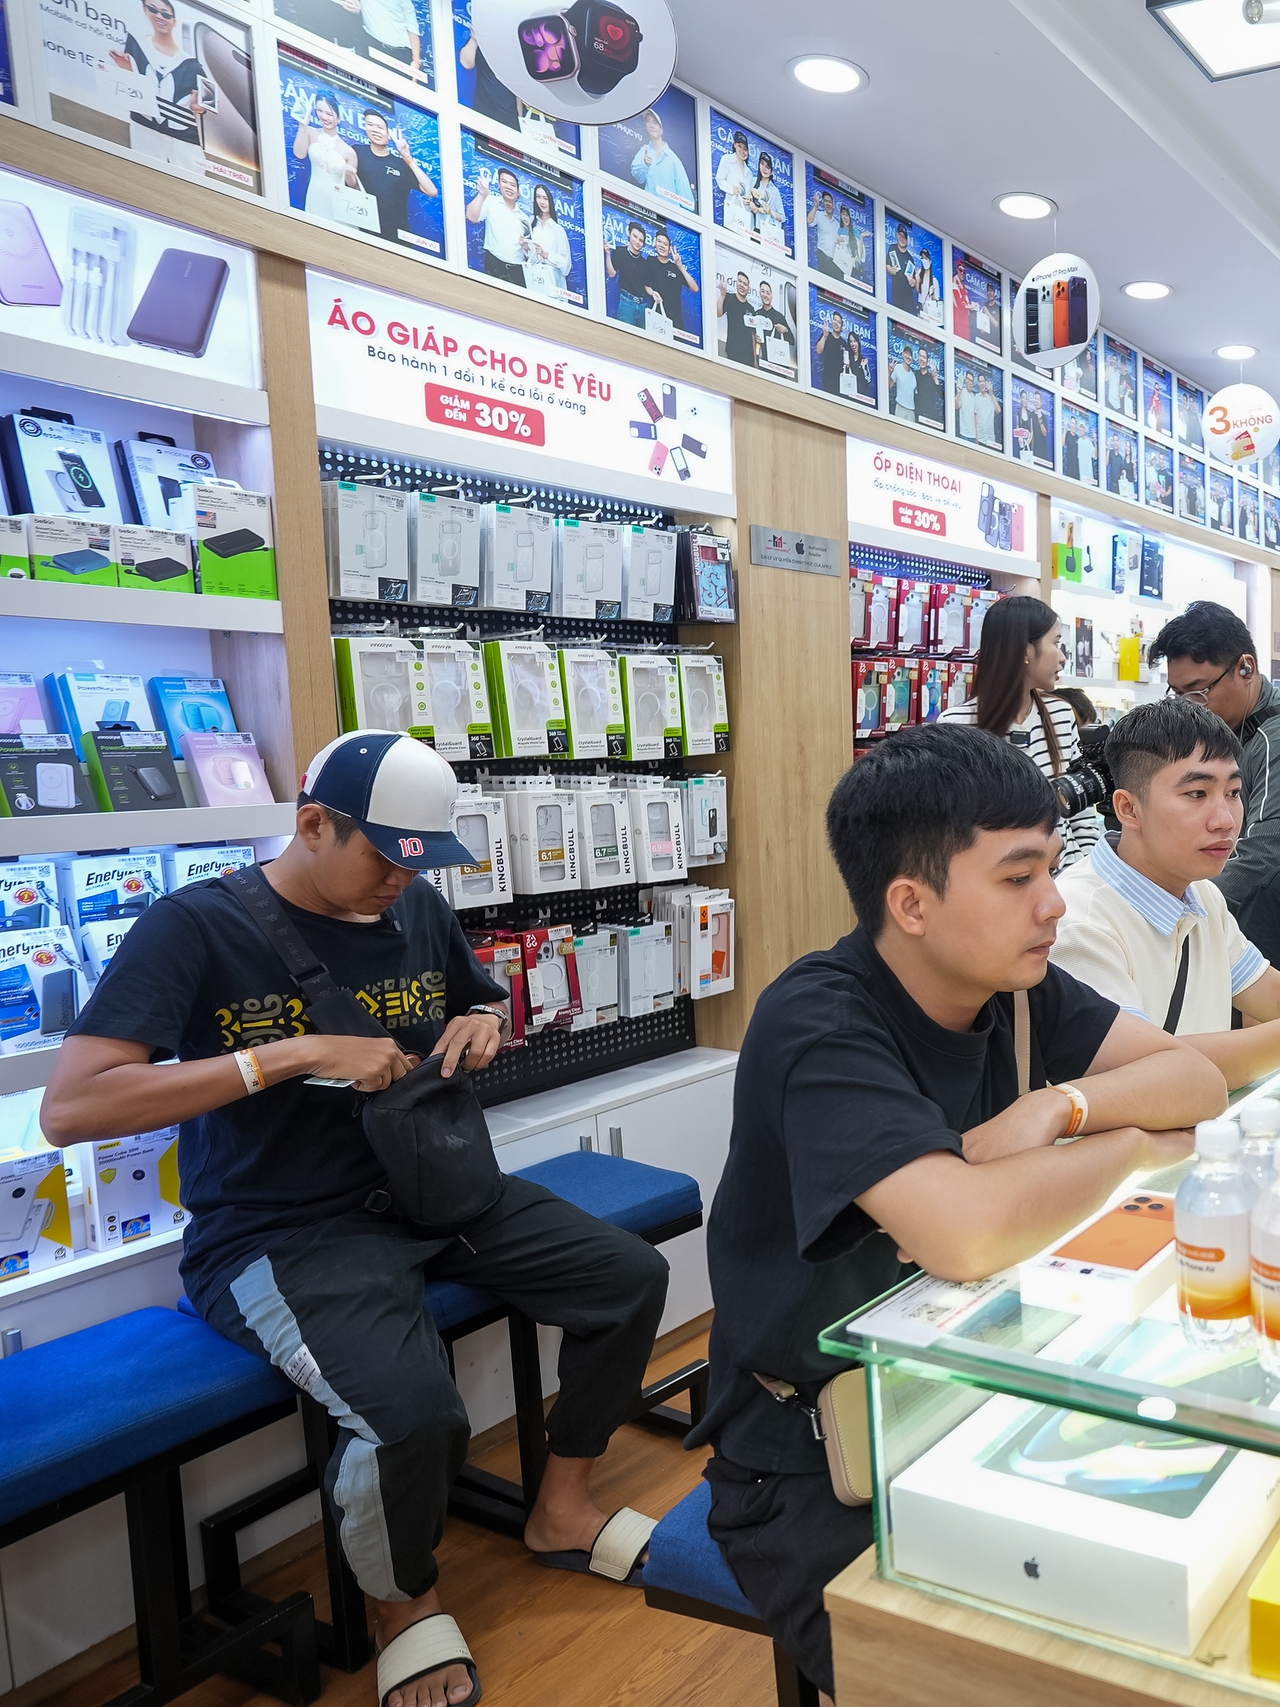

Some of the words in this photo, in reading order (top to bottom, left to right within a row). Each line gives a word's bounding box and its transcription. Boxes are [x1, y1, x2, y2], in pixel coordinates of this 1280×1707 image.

[593, 41, 605, 51] 68
[1036, 271, 1052, 282] iPhone
[327, 298, 376, 336] ÁO
[387, 321, 459, 356] GIÁP
[468, 345, 528, 378] CHO
[536, 362, 569, 390] DẾ
[573, 372, 612, 403] YÊU
[367, 345, 397, 364] Bảo
[401, 354, 437, 374] hành
[454, 368, 475, 385] đổi
[490, 377, 506, 392] kể
[509, 382, 525, 397] cả
[558, 396, 587, 415] vàng
[439, 394, 471, 411] GIẢM
[444, 408, 467, 423] ĐẾN
[474, 402, 532, 438] 30%
[1208, 406, 1231, 435] 3
[1231, 414, 1273, 430] KHÔNG
[873, 451, 892, 472] ỐP
[896, 461, 923, 484] ĐIỆN
[927, 471, 962, 496] THOẠI
[914, 511, 940, 531] 30%
[398, 837, 424, 857] 10
[541, 852, 552, 860] 6.1
[568, 829, 576, 879] KINGBULL
[596, 848, 606, 857] 6.7
[621, 826, 631, 874] KINGBULL
[674, 823, 683, 869] KINGBULL
[495, 838, 506, 892] KINGBULL
